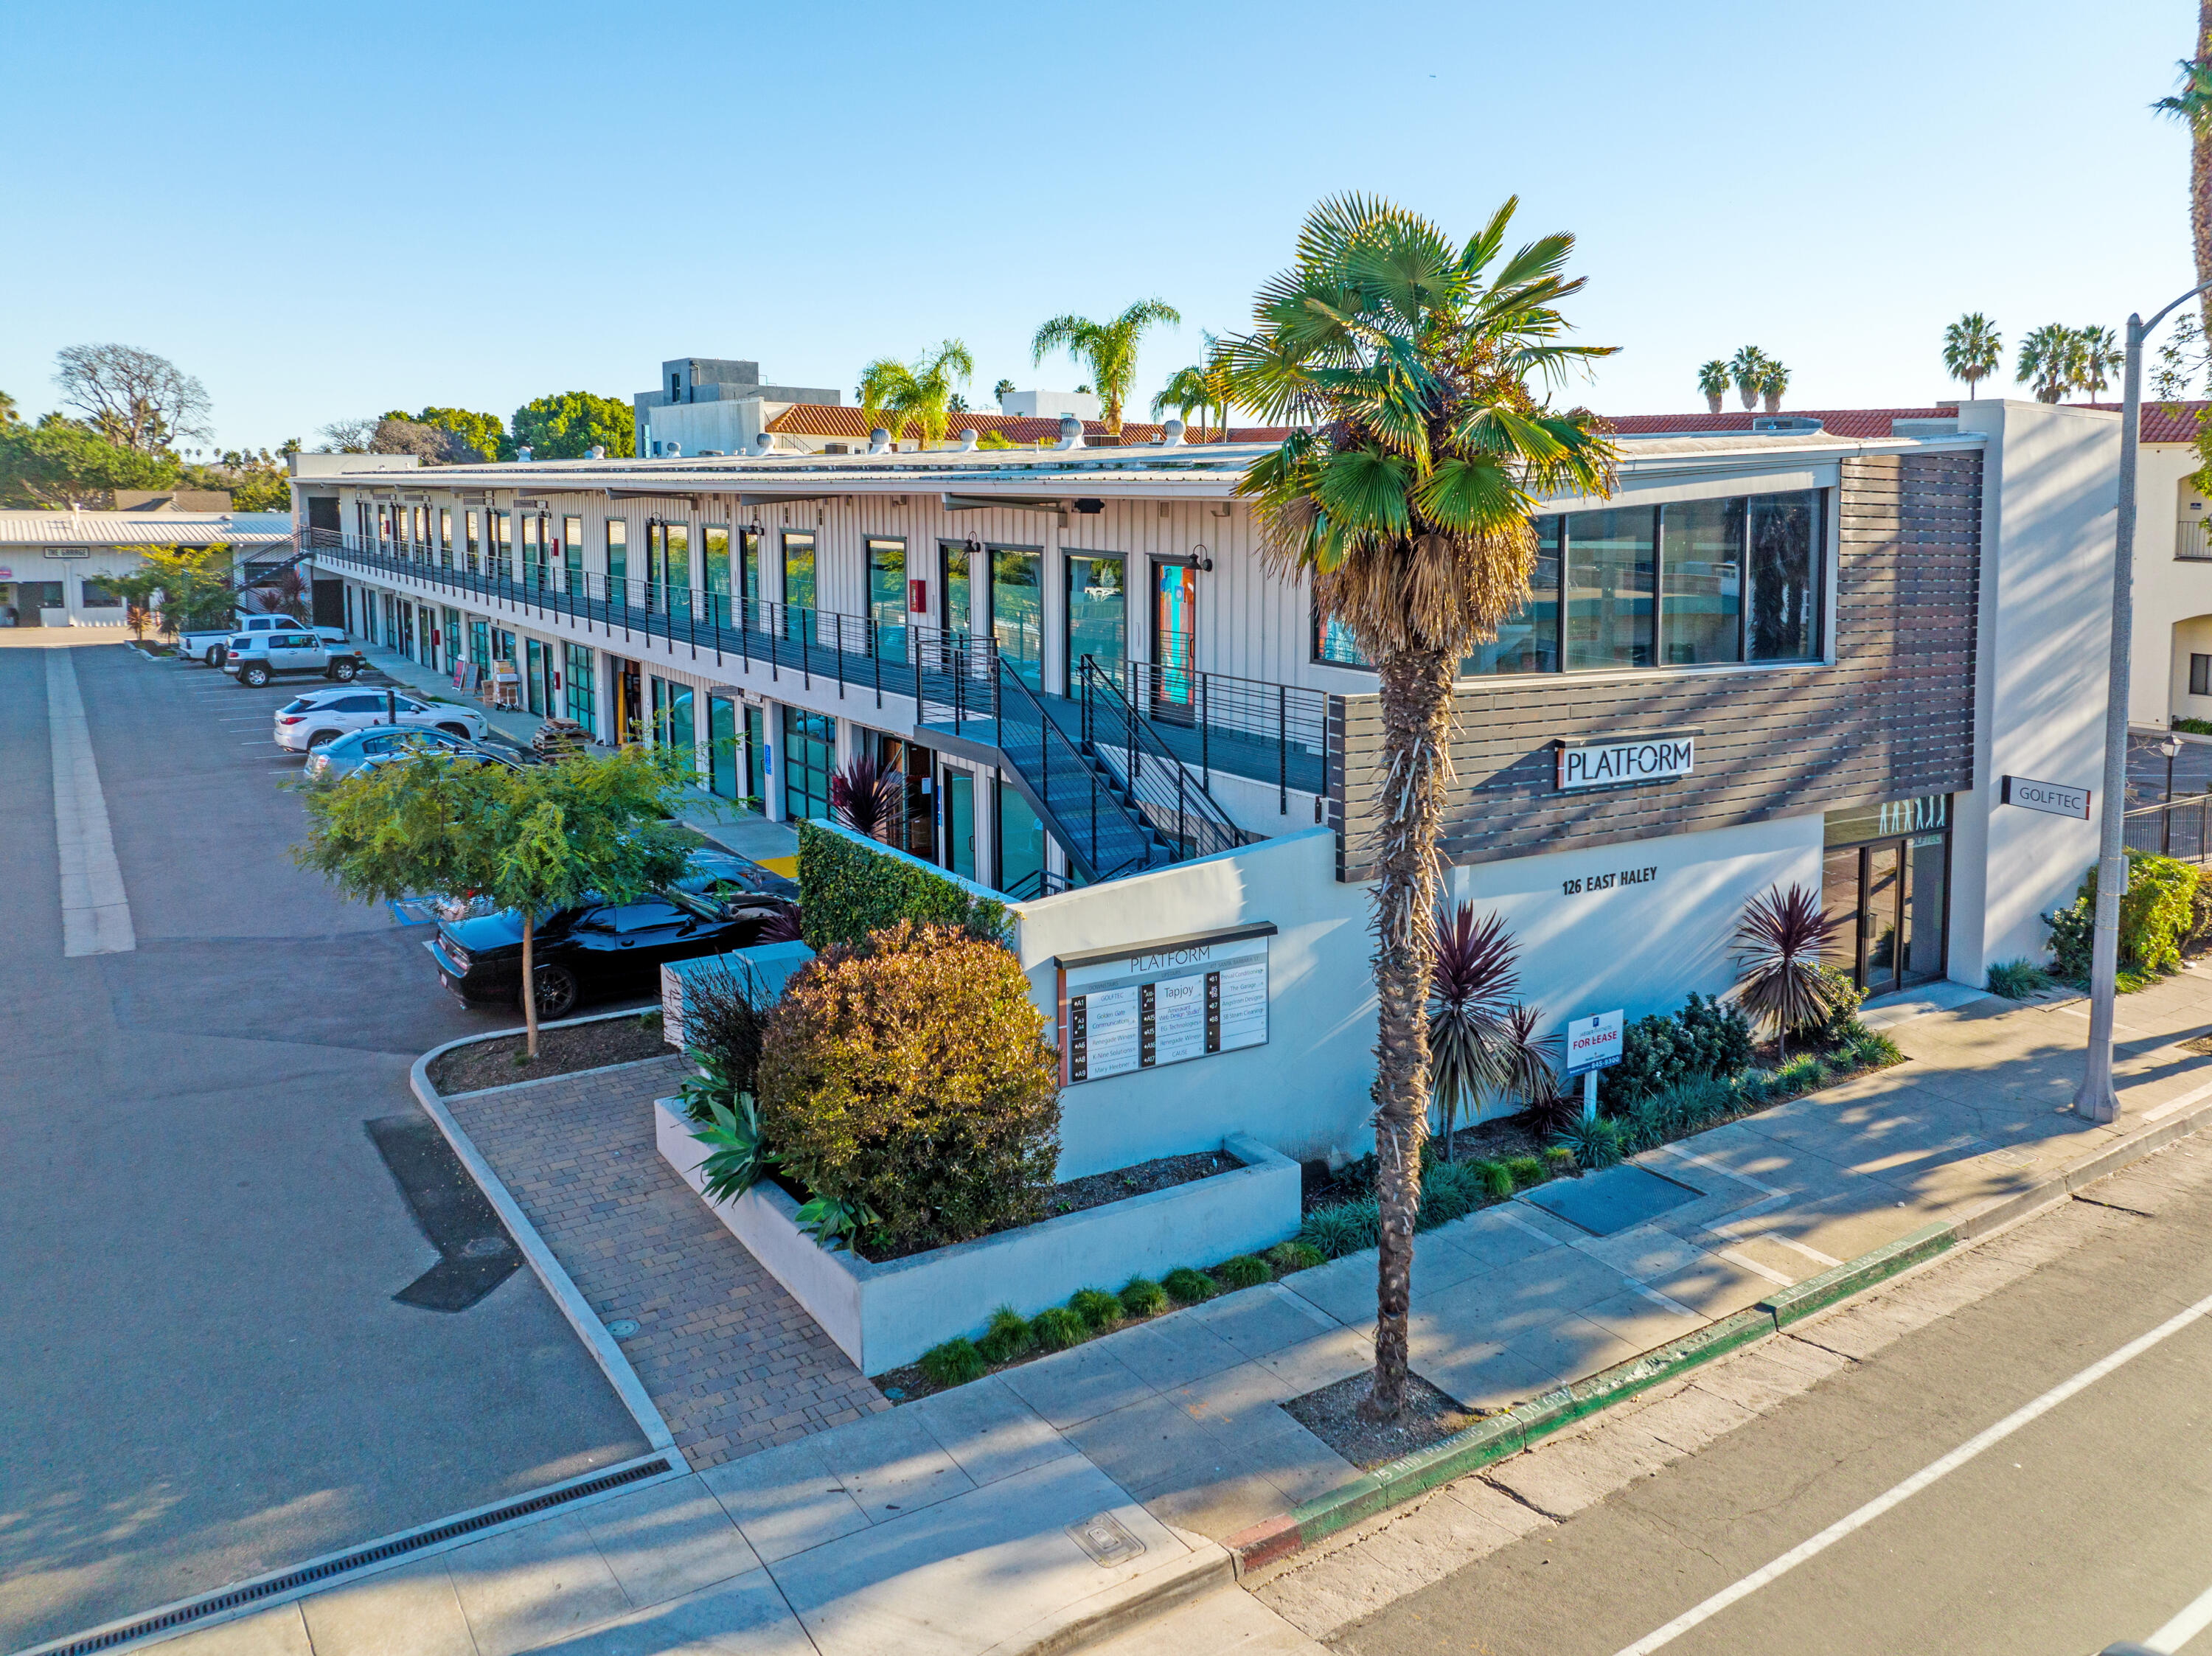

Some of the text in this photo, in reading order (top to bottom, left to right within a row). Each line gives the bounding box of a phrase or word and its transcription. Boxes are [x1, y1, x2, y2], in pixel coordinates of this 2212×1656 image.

[1568, 742, 1691, 782] PLATFORM
[2020, 787, 2081, 810] GOLFTEC
[1562, 866, 1658, 895] 126 EAST HALEY
[1130, 946, 1210, 973] PLATFORM
[1088, 981, 1119, 991] DOWNSTAIRS
[1240, 983, 1256, 991] Garage
[1101, 992, 1124, 1001] GOLFTEC
[1164, 985, 1194, 999] Tapjoy
[1169, 1020, 1199, 1030] Technologies
[1092, 1035, 1116, 1046] Renegade
[1161, 1037, 1183, 1046] Renegade
[1573, 1037, 1590, 1050] FOR
[1592, 1030, 1617, 1046] LEASE
[1110, 1048, 1133, 1057] Solutions
[1095, 1066, 1107, 1074] Mary
[1393, 1455, 1422, 1472] MIN
[1423, 1427, 1484, 1455] PARKING
[1523, 1403, 1541, 1416] TO
